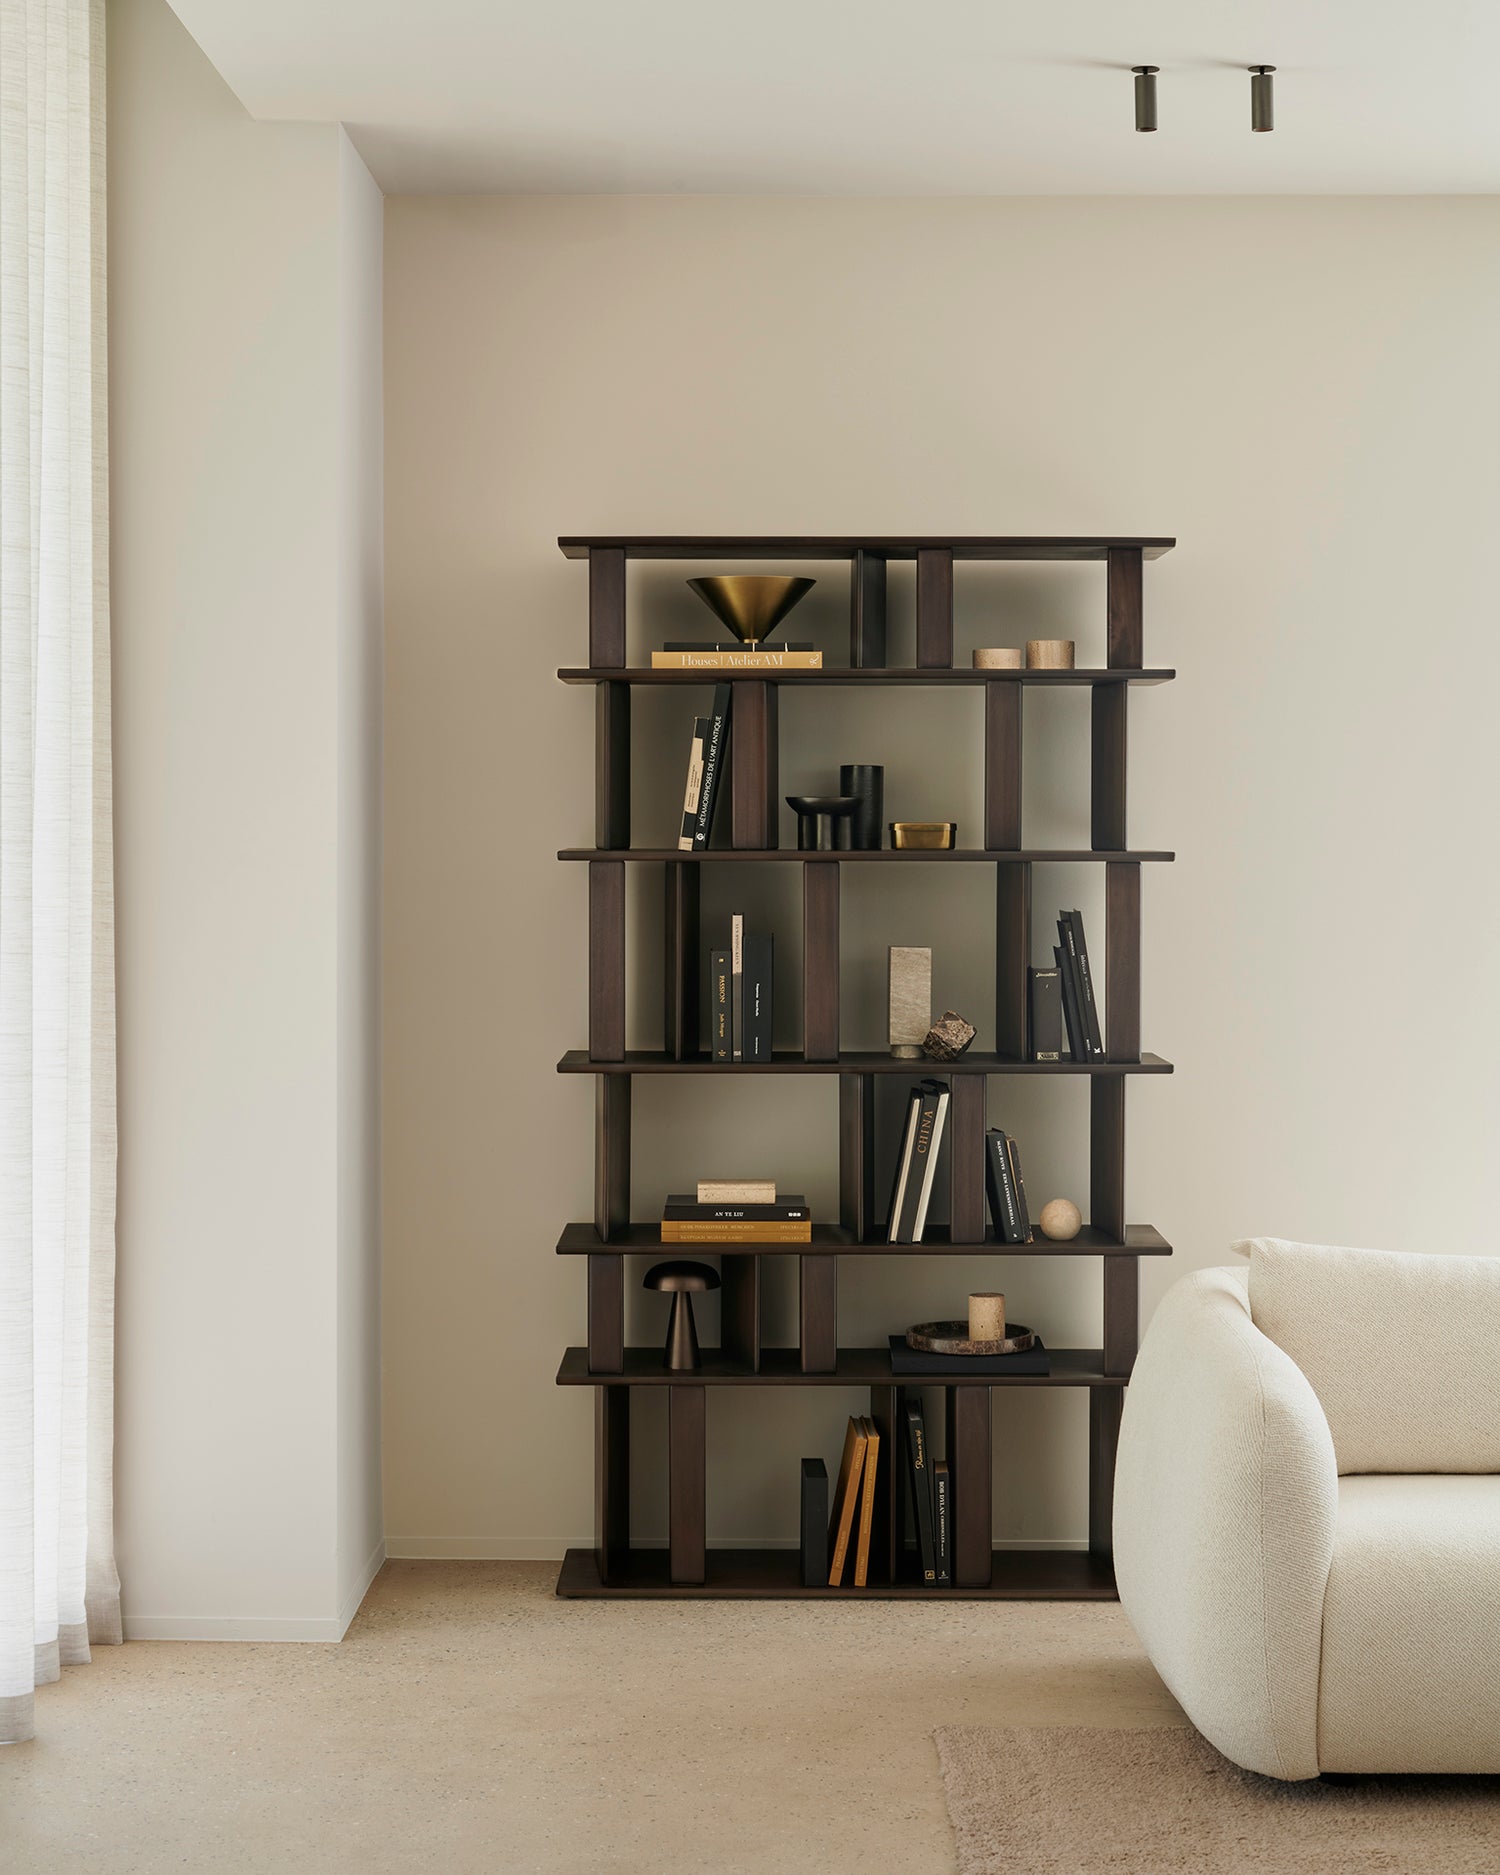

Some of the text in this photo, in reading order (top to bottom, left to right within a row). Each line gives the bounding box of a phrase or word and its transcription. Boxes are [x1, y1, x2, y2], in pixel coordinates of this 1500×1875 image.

[682, 654, 783, 666] Houses Atelier AM
[700, 716, 722, 827] MÉTAMORPHOSES DE L'ART ANTIQUE
[917, 1110, 933, 1154] CHINA
[1005, 1184, 1015, 1226] LEVENSVERHAAL
